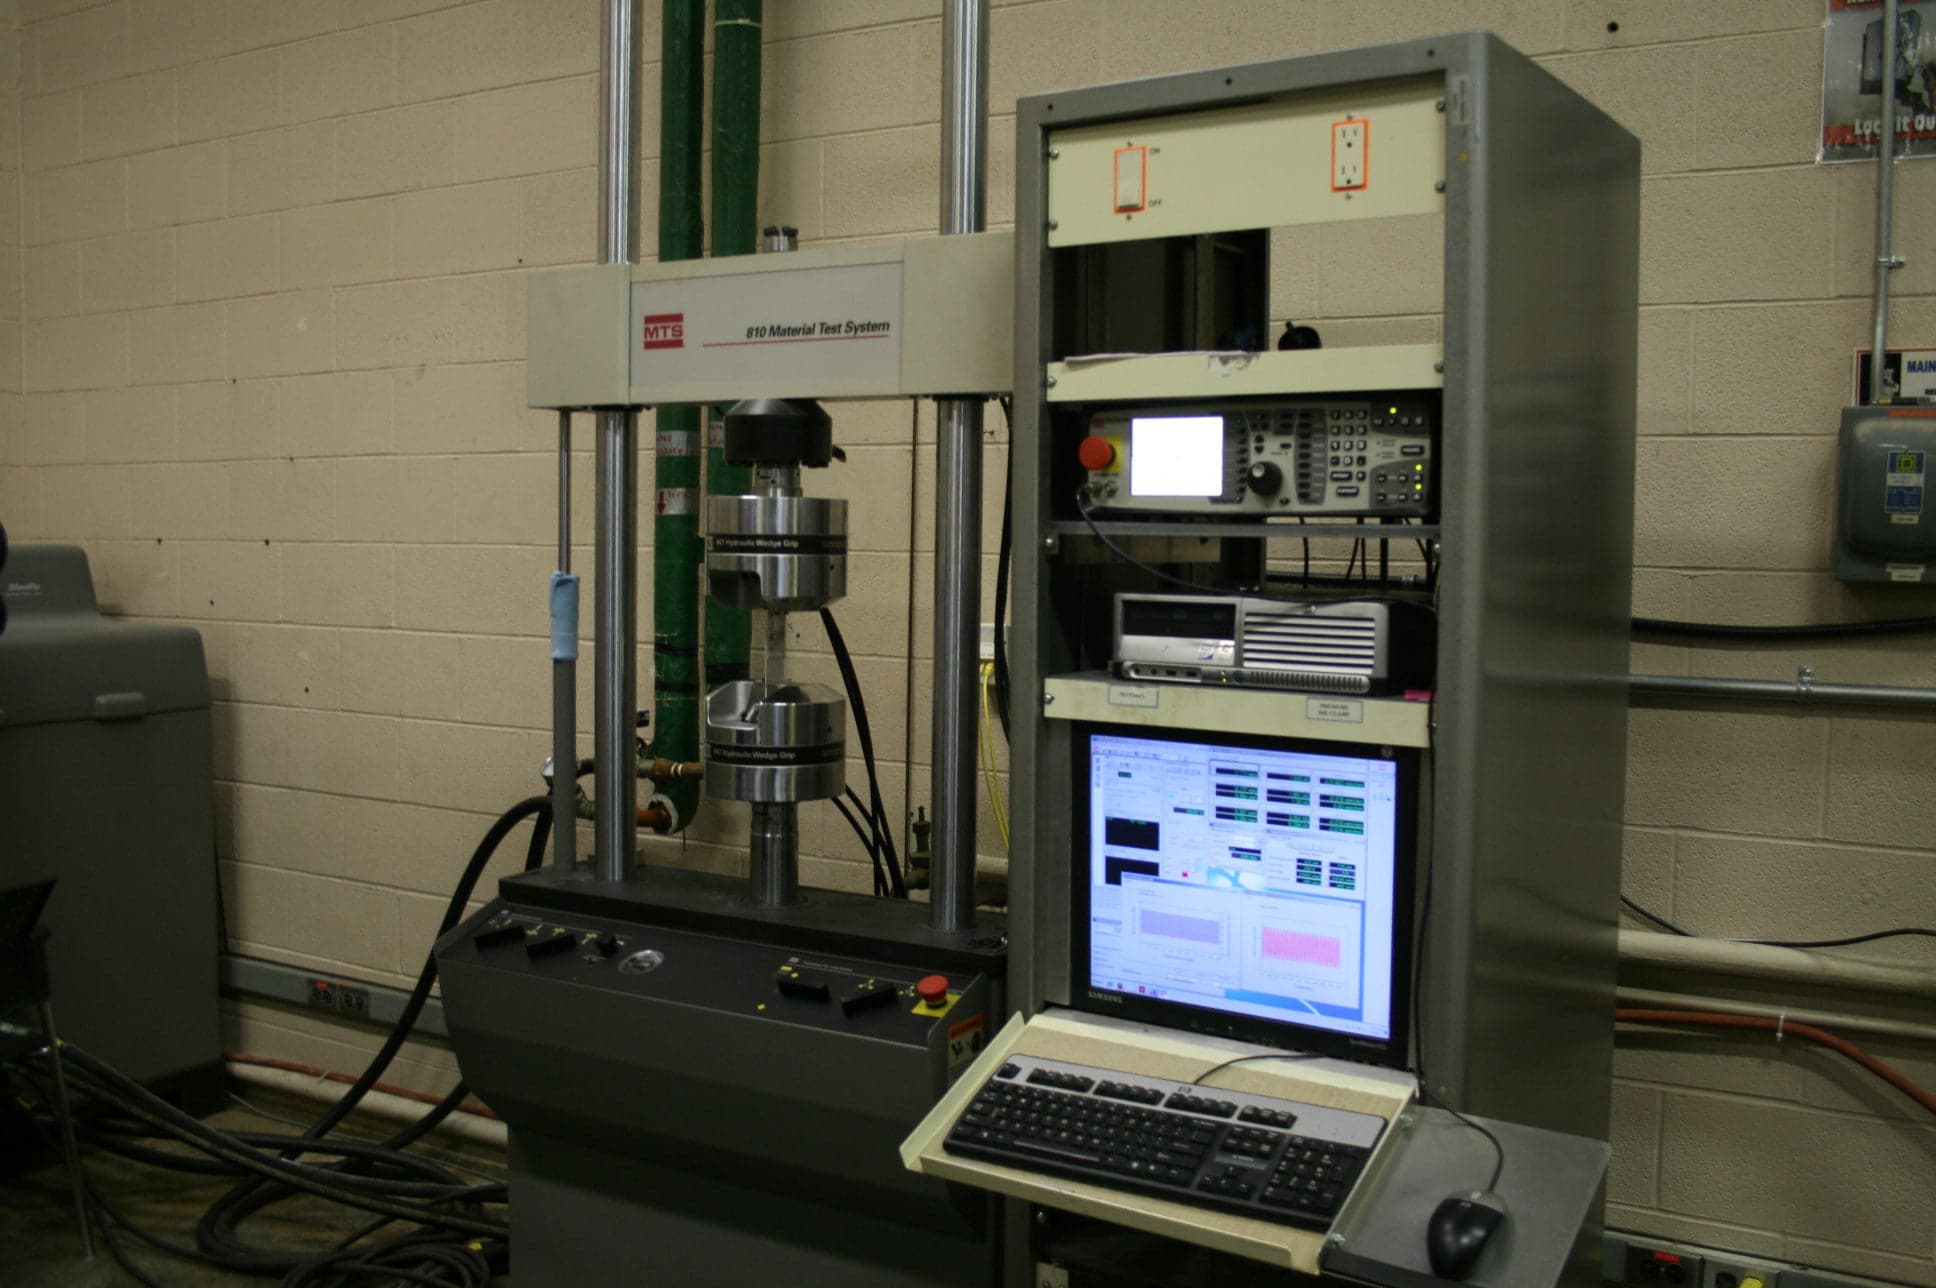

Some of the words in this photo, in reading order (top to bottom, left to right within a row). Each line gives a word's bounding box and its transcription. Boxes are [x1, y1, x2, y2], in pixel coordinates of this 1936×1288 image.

[1855, 118, 1881, 136] Loc
[644, 324, 684, 339] MTS
[746, 325, 767, 339] 810
[768, 322, 816, 338] Material
[819, 320, 842, 335] Test
[844, 320, 890, 336] System
[756, 538, 782, 549] Wedge
[783, 538, 799, 549] Grip
[752, 751, 778, 761] Wedge
[780, 751, 796, 762] Grip
